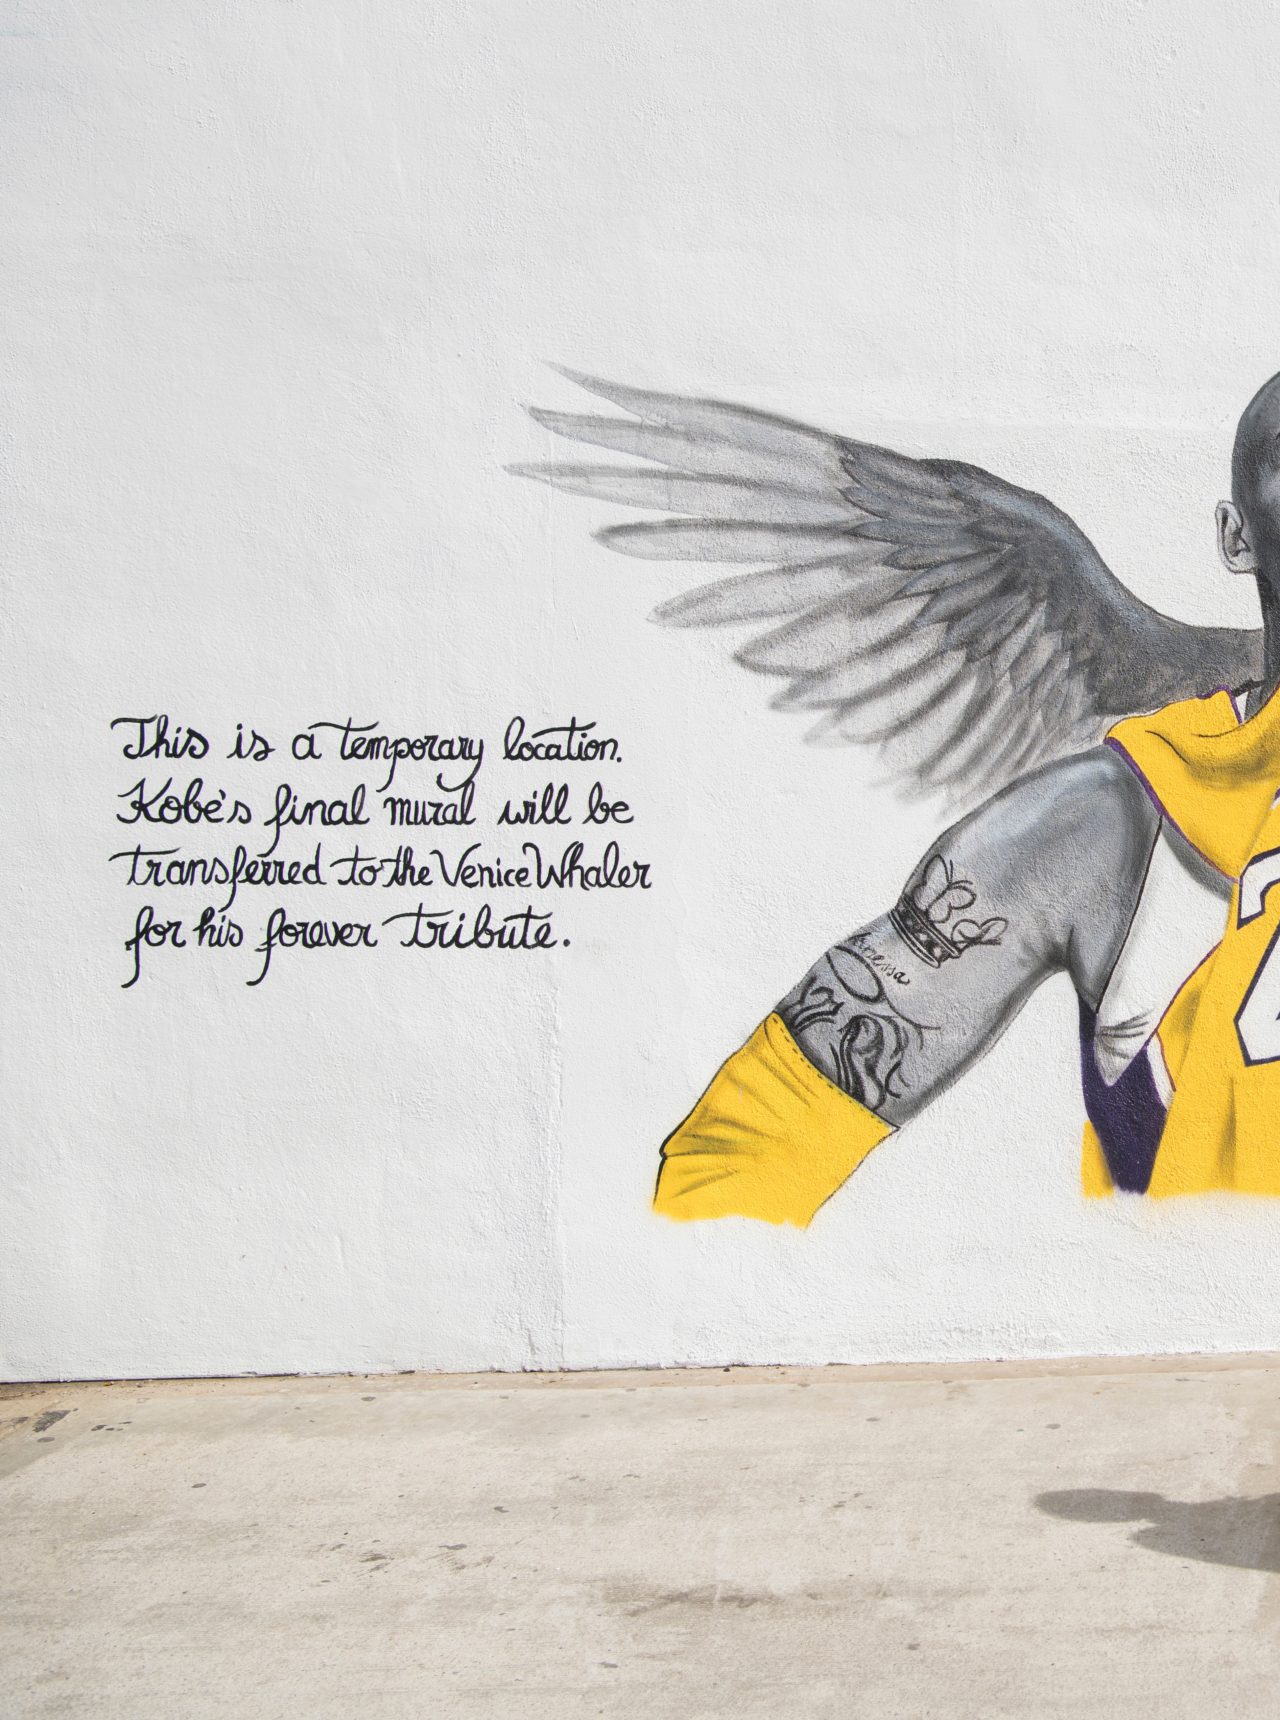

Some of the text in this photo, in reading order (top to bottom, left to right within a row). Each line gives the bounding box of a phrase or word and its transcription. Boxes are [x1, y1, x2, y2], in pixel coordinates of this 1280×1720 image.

[110, 713, 624, 793] This is a temporary location.
[116, 777, 635, 858] Kobe's final mural will be
[108, 840, 653, 913] transferred to the Venice Whaler
[121, 902, 573, 988] for his forever tribute.
